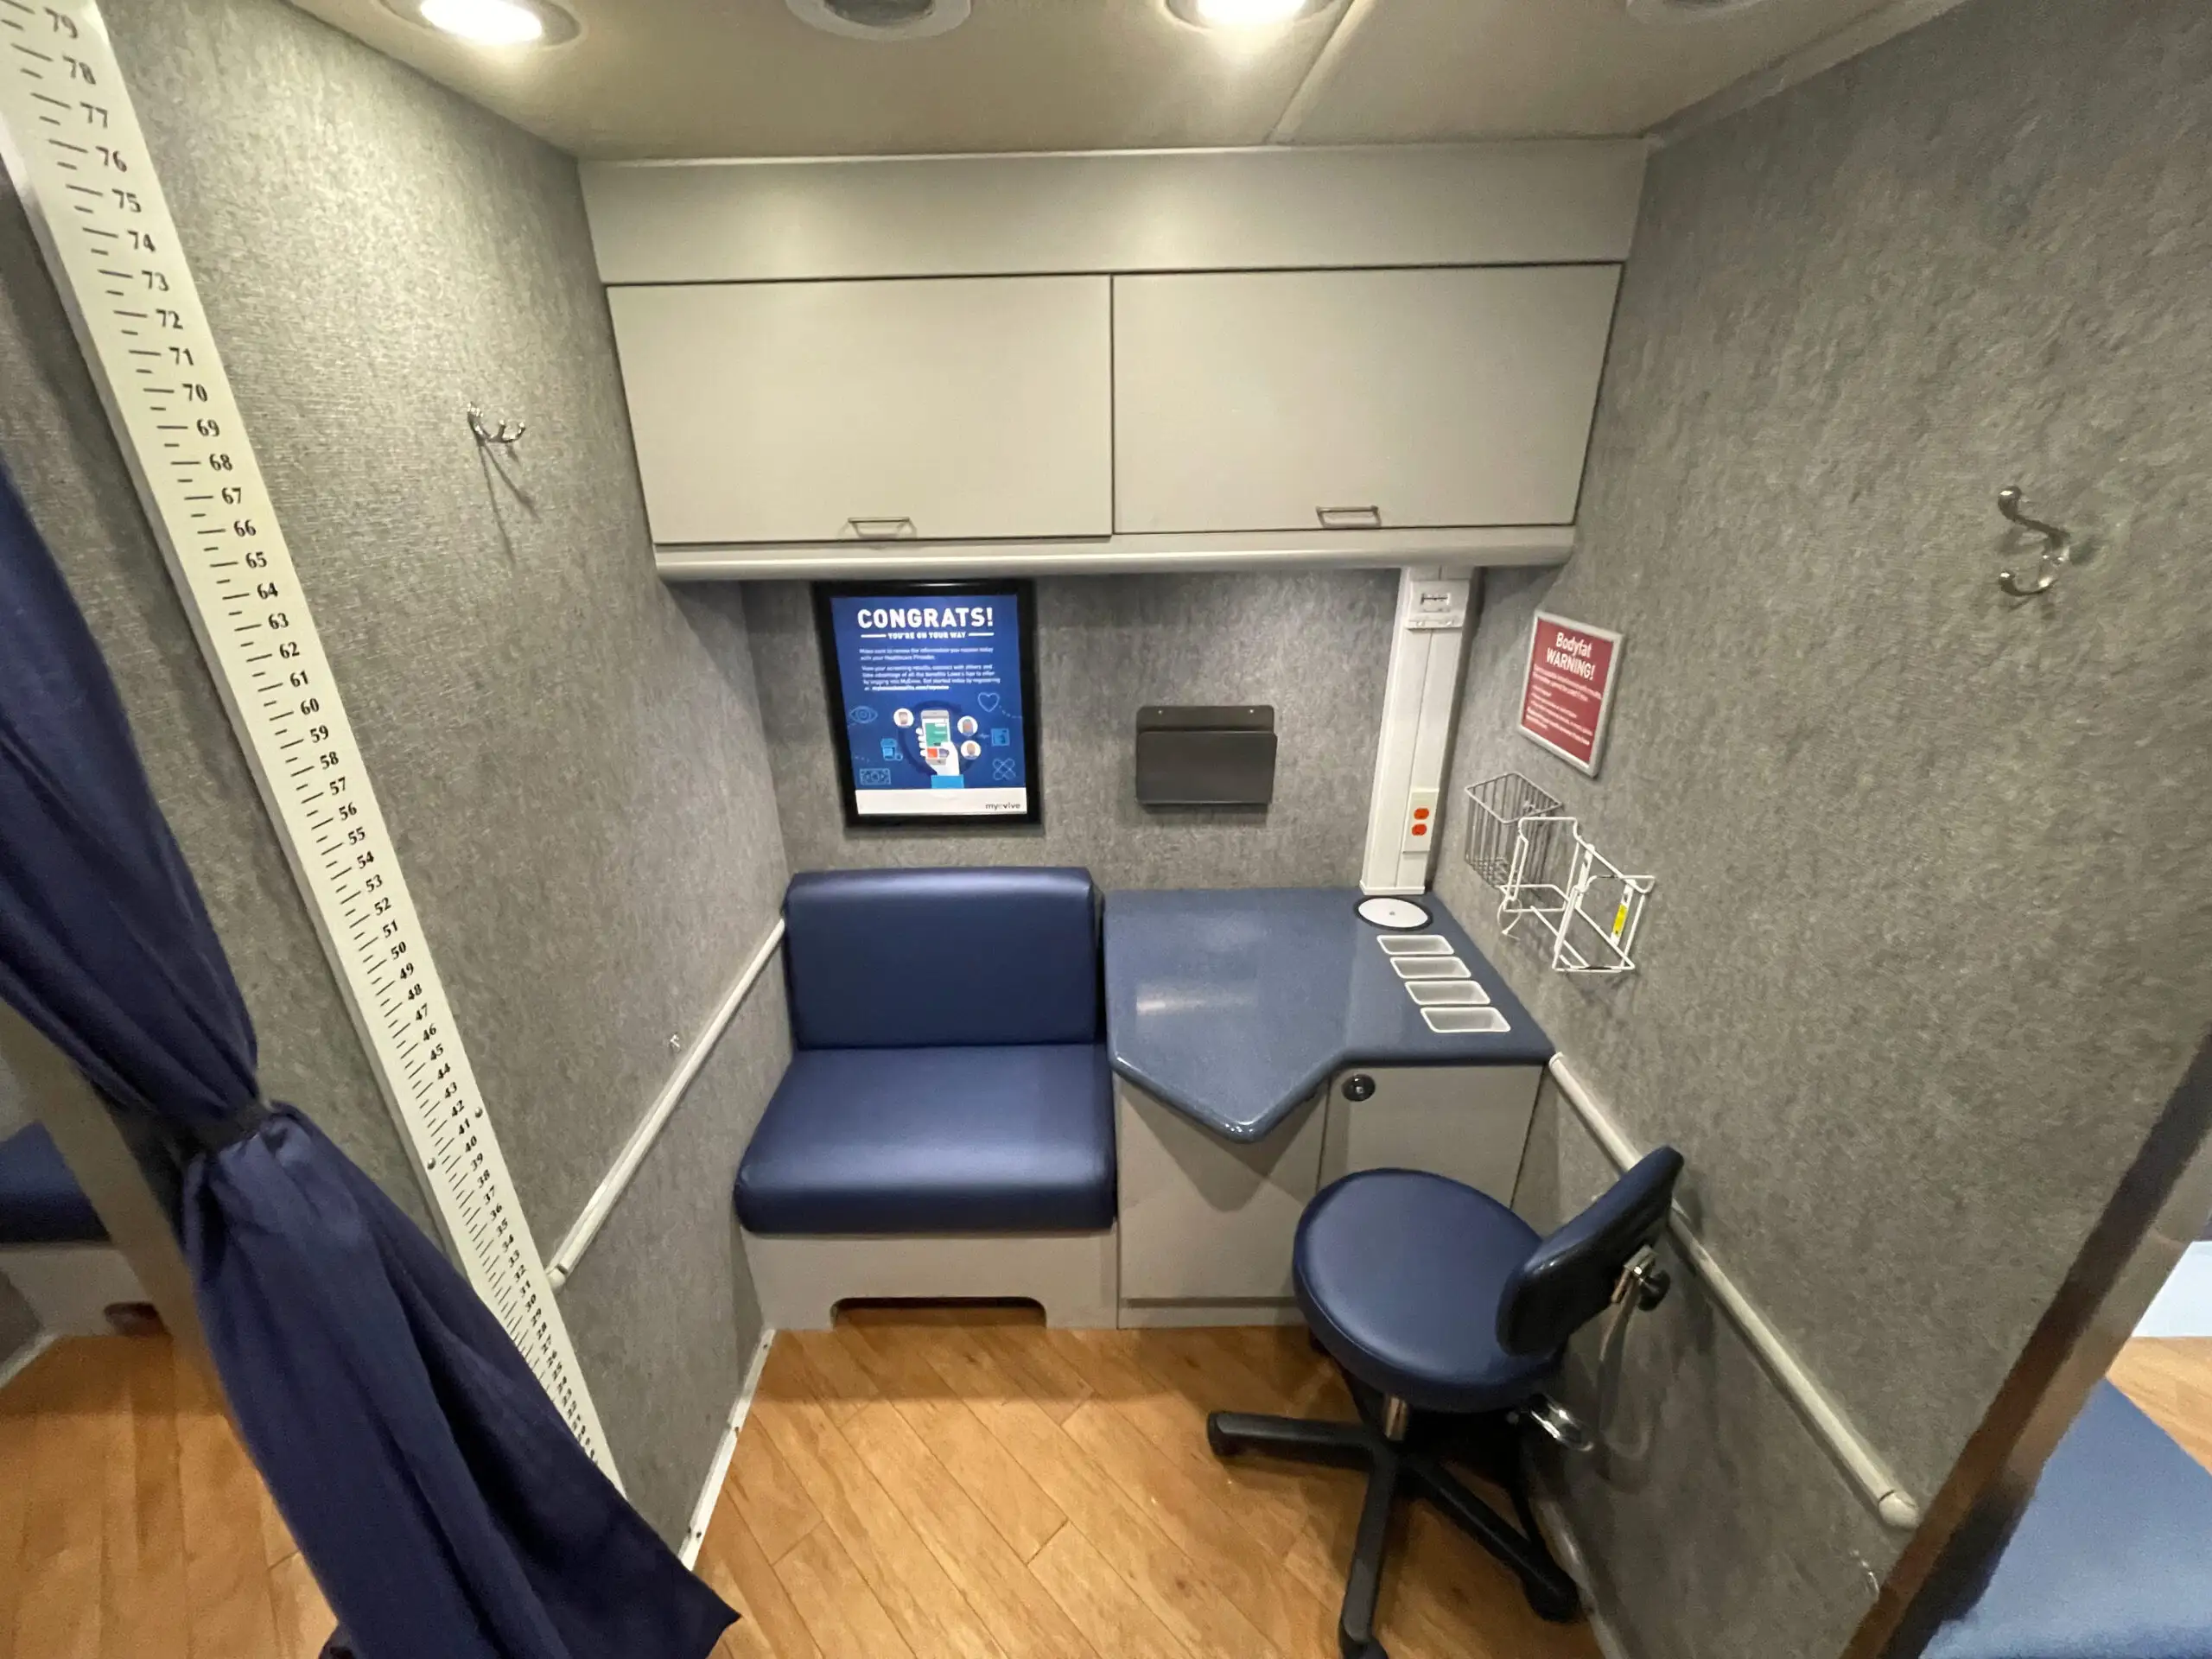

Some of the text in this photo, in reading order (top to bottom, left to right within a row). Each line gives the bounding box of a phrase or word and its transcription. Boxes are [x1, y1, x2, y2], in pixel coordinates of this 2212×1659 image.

[43, 7, 79, 39] 79
[62, 54, 96, 85] 78
[79, 101, 108, 129] 77
[95, 145, 127, 173] 76
[111, 188, 142, 213] 75
[127, 229, 156, 252] 74
[141, 270, 169, 291] 73
[156, 308, 183, 330] 72
[168, 346, 194, 366] 71
[181, 383, 208, 403] 70
[196, 418, 220, 437] 69
[209, 453, 233, 472] 68
[221, 486, 242, 505] 67
[233, 519, 257, 537] 66
[245, 551, 268, 569] 65
[257, 582, 278, 600] 64
[268, 612, 289, 630] 63
[856, 607, 994, 629] CONGRATS!
[279, 641, 300, 659] 62
[1555, 632, 1592, 658] Bodyfat
[1547, 646, 1596, 681] WARNING!
[289, 670, 309, 688] 61
[300, 697, 320, 715] 60
[309, 724, 329, 744] 59
[320, 751, 340, 770] 58
[329, 776, 346, 796] 57
[338, 801, 358, 821] 56
[347, 826, 366, 846] 55
[356, 850, 375, 869] 54
[365, 874, 383, 893] 53
[374, 896, 392, 916] 52
[382, 919, 398, 938] 51
[391, 941, 406, 961] 50
[399, 963, 415, 980] 49
[407, 983, 423, 1001] 48
[415, 1002, 428, 1021] 47
[423, 1023, 437, 1041] 46
[430, 1043, 444, 1061] 45
[437, 1063, 451, 1080] 44
[444, 1082, 458, 1099] 43
[451, 1100, 465, 1117] 42
[458, 1118, 471, 1135] 41
[465, 1135, 477, 1153] 40
[471, 1153, 484, 1172] 39
[477, 1169, 491, 1189] 38
[484, 1185, 495, 1205] 37
[490, 1203, 503, 1222] 36
[496, 1217, 508, 1238] 35
[502, 1234, 514, 1254] 34
[508, 1249, 520, 1268] 33
[514, 1264, 527, 1283] 32
[520, 1280, 531, 1298] 31
[525, 1294, 536, 1313] 30
